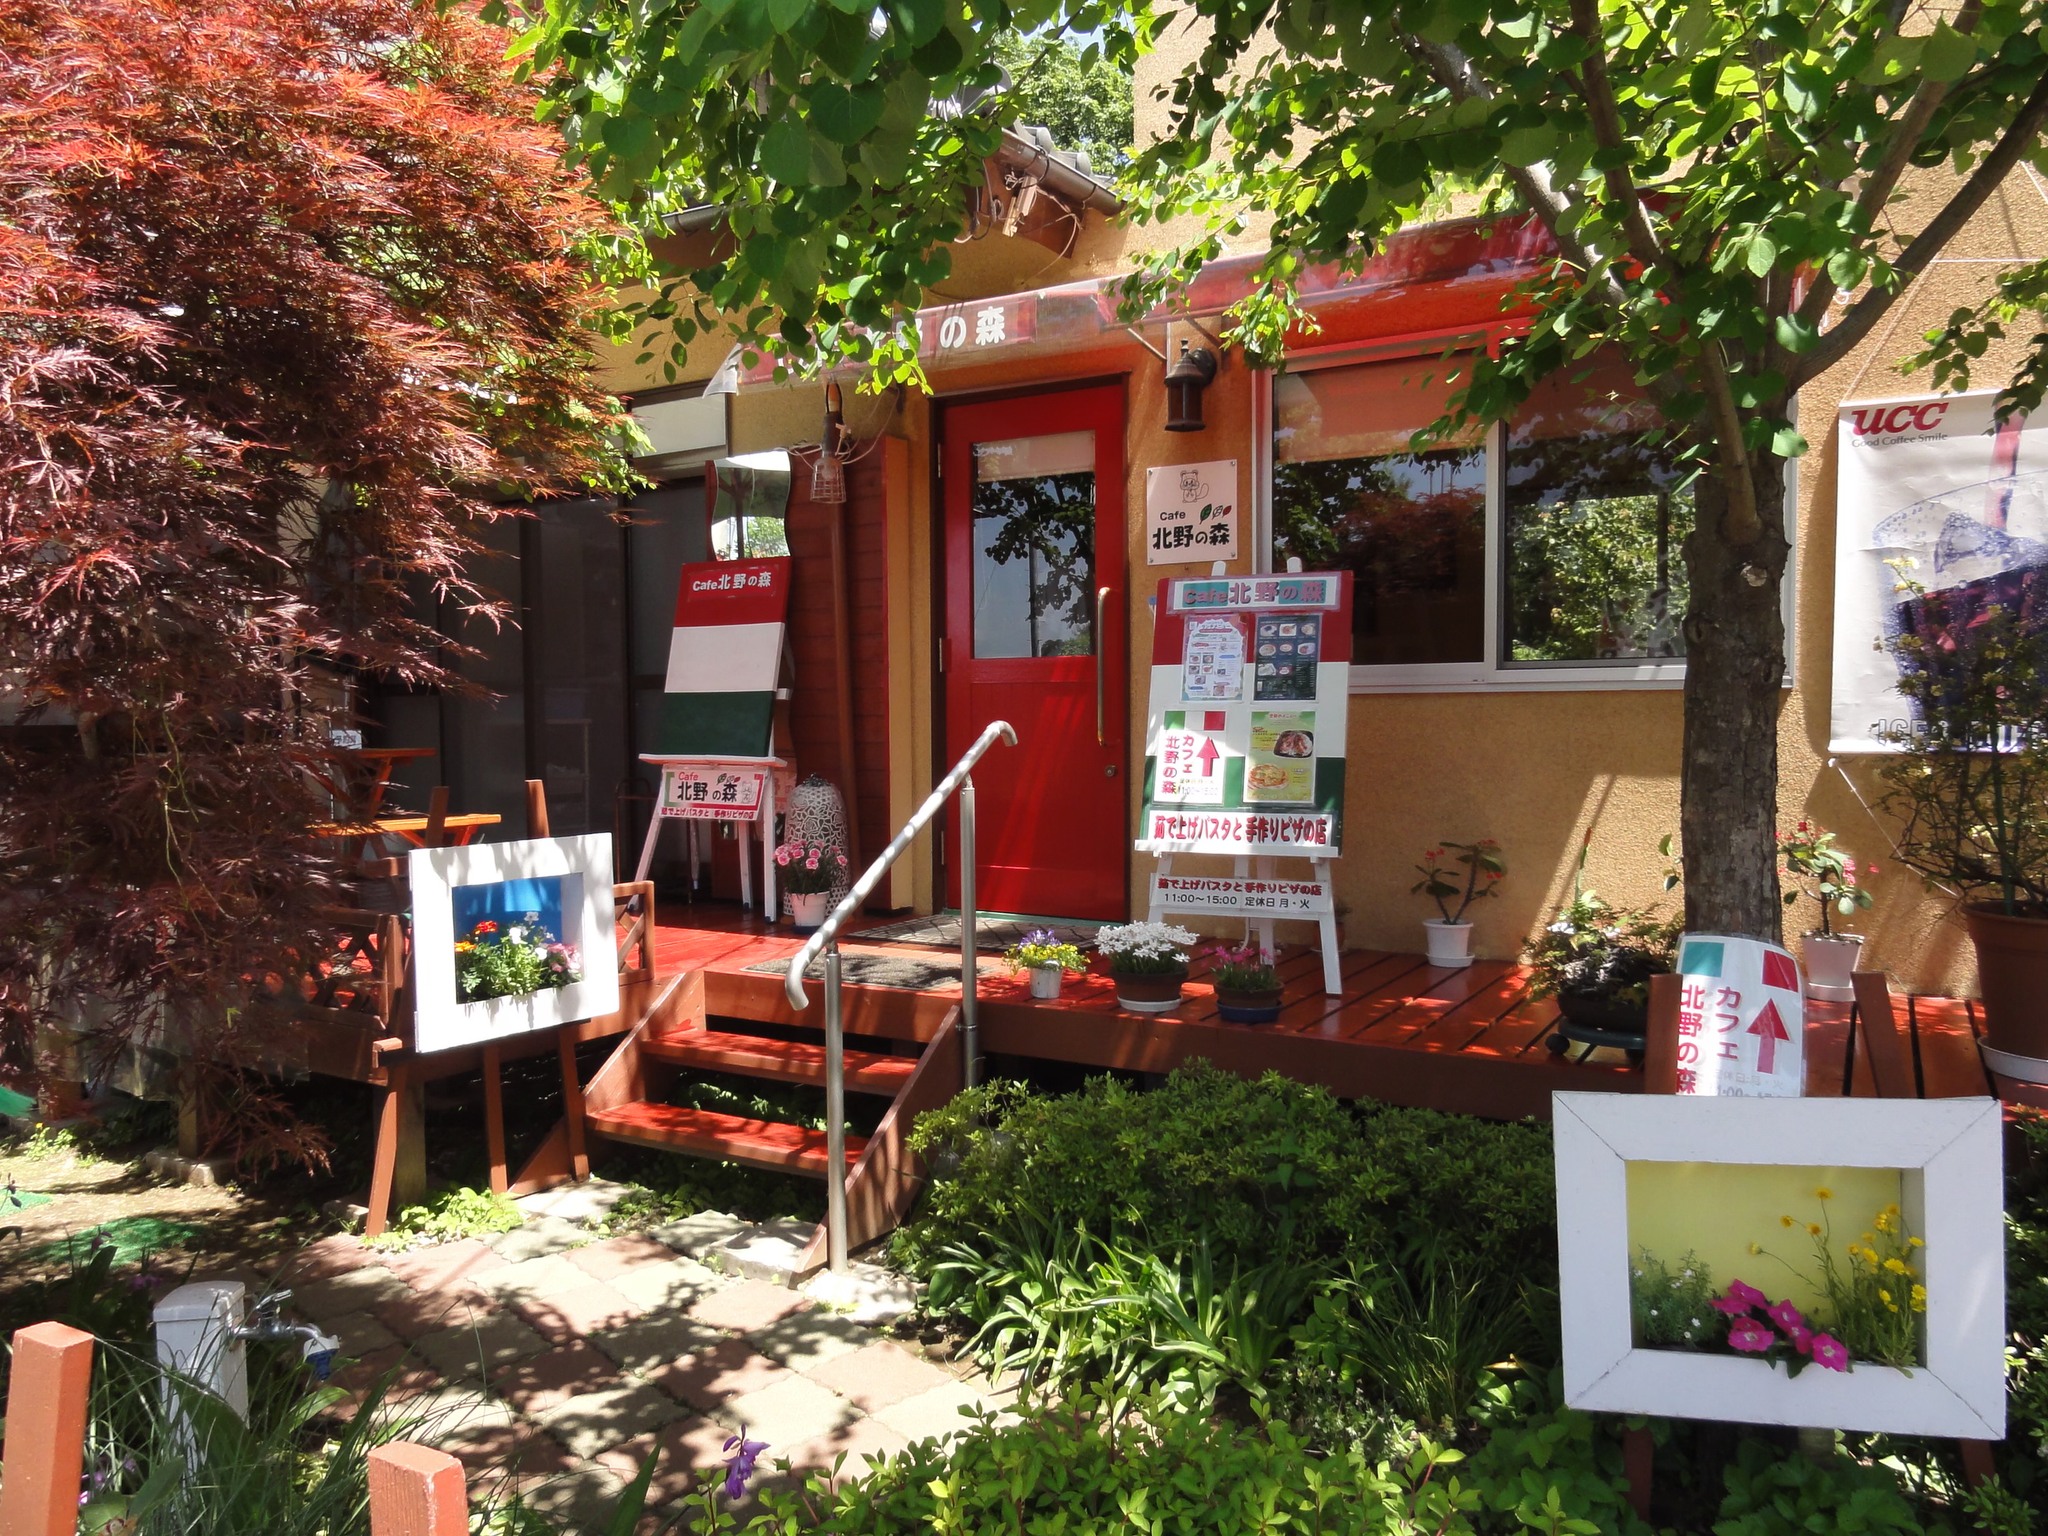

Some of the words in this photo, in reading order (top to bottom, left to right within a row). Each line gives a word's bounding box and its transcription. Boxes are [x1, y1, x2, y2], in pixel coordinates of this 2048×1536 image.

[1852, 438, 1879, 448] Good
[1882, 436, 1916, 446] Coffee
[1918, 433, 1948, 443] Smile
[1160, 510, 1186, 521] Cafe
[1153, 523, 1230, 549] 北野の森
[1162, 736, 1180, 794] 北野の森
[678, 772, 699, 781] Cafe
[677, 781, 737, 802] 北野の森
[1245, 897, 1275, 907] 定休日
[1676, 984, 1705, 1094] 北野の森
